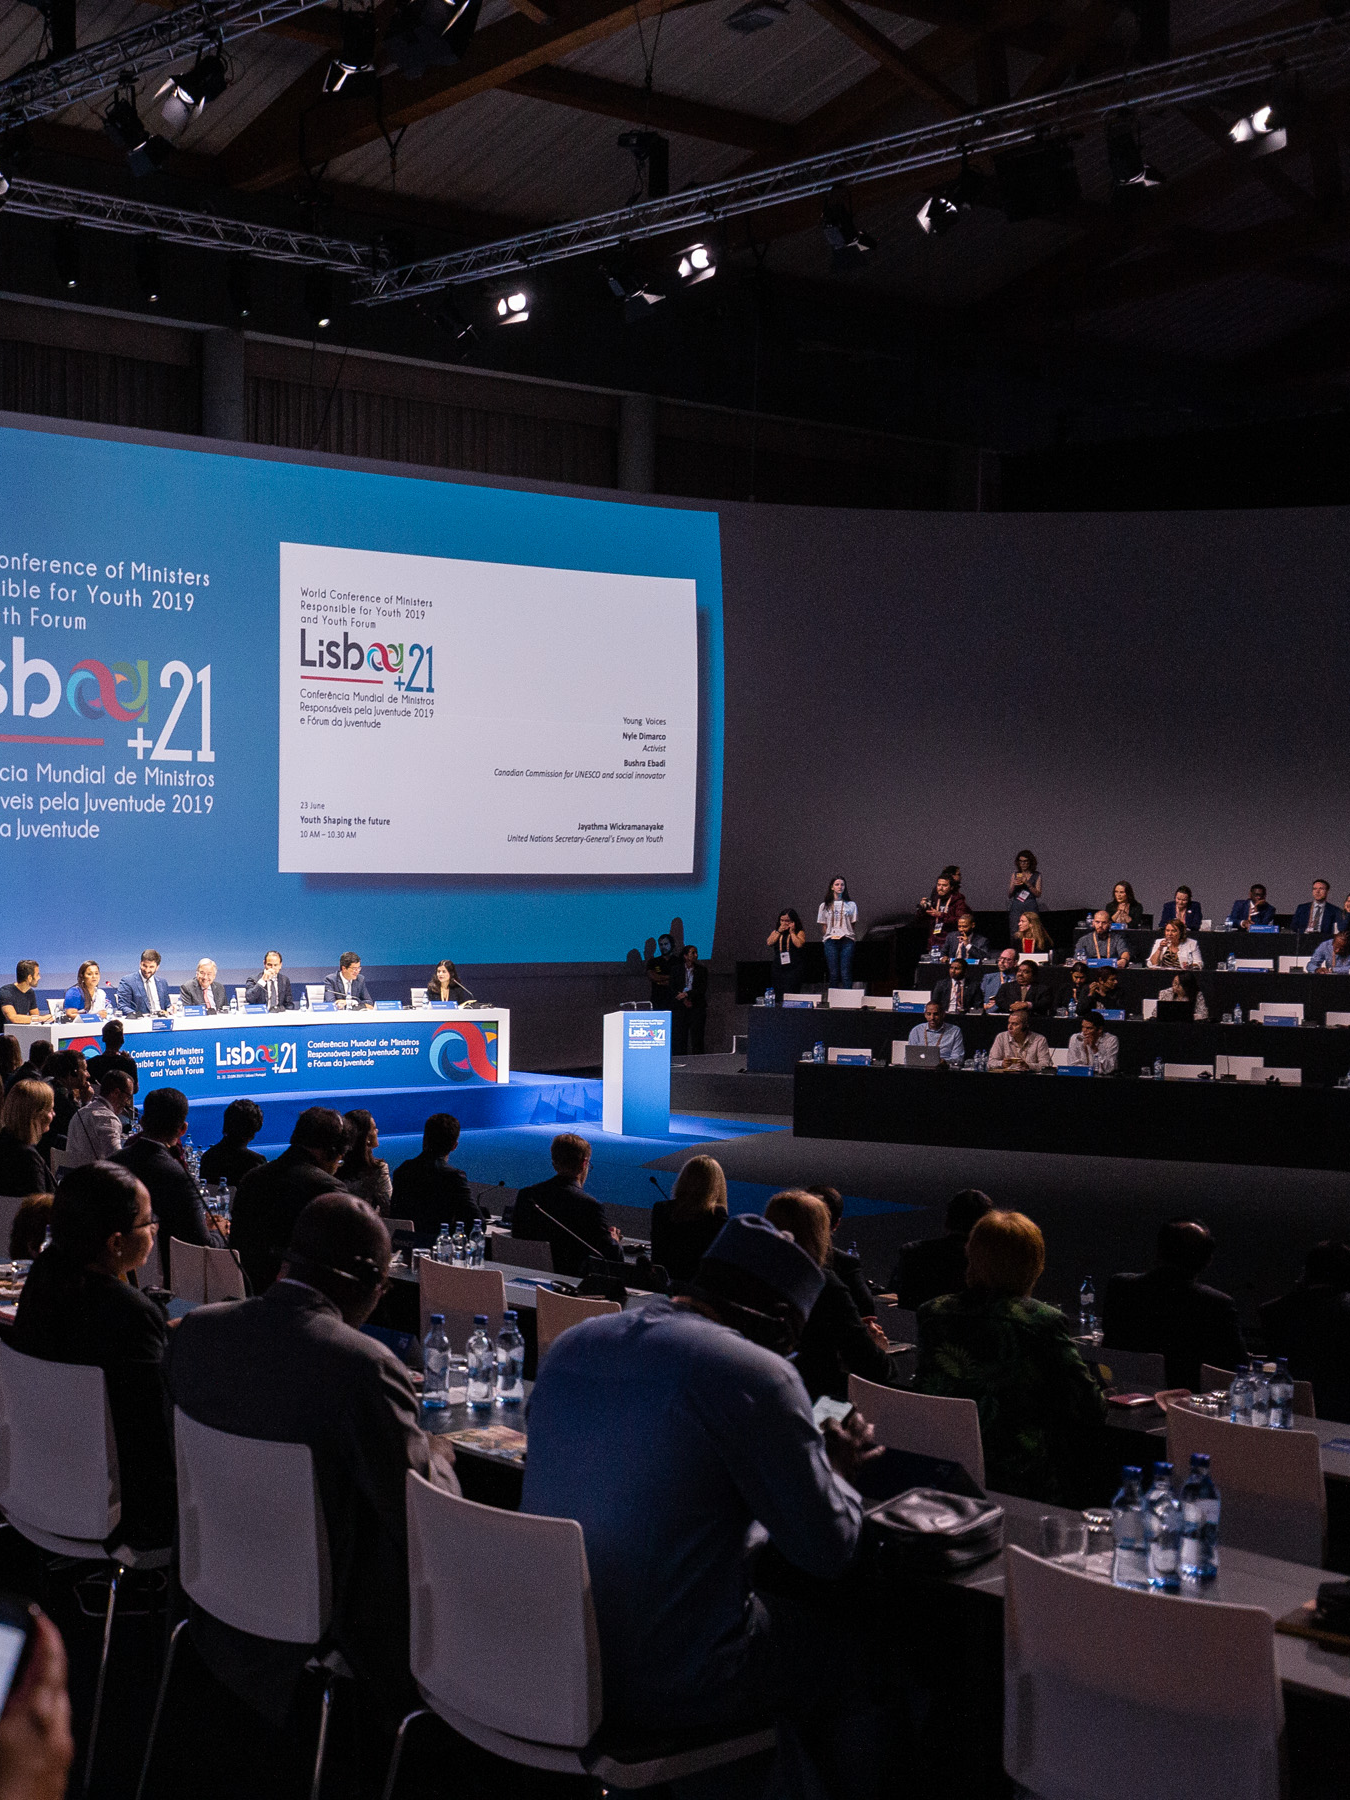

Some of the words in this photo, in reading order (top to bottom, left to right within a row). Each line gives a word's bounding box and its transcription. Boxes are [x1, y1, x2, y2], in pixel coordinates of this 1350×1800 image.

[106, 561, 122, 579] of
[131, 562, 210, 587] Ministers
[50, 582, 76, 602] for
[88, 585, 142, 608] Youth
[152, 591, 194, 611] 2019
[301, 587, 326, 598] World
[330, 590, 381, 604] Conference
[384, 596, 393, 604] of
[396, 596, 432, 607] Ministers
[301, 601, 356, 614] Responsible
[360, 606, 371, 615] for
[376, 607, 401, 618] Youth
[405, 609, 425, 619] 2019
[31, 608, 86, 630] Forum
[301, 615, 318, 624] and
[322, 616, 347, 626] Youth
[351, 618, 376, 628] Forum
[300, 688, 349, 700] Conferência
[353, 692, 384, 702] Mundial
[388, 694, 398, 703] de
[402, 695, 434, 705] Ministros
[300, 702, 352, 714] Responsáveis
[355, 706, 372, 716] pela
[374, 708, 411, 717] Juventude
[414, 708, 434, 718] 2019
[307, 715, 329, 726] Fórum
[332, 717, 342, 726] da
[344, 718, 381, 728] Juventude
[623, 717, 642, 726] Young
[622, 732, 637, 741] Nyle
[37, 763, 105, 784] Mundial
[114, 766, 136, 784] de
[145, 768, 214, 787] Ministros
[494, 768, 523, 777] Canadian
[525, 769, 562, 778] Commission
[563, 771, 573, 779] for
[602, 771, 614, 779] and
[616, 771, 633, 779] social
[635, 772, 665, 780] innovator
[40, 792, 79, 813] pela
[84, 792, 165, 814] Juventude
[172, 795, 213, 814] 2019
[300, 816, 321, 824] Youth
[323, 816, 351, 826] Shaping
[354, 817, 366, 825] the
[369, 817, 390, 825] future
[578, 823, 608, 831] Jayathma
[609, 823, 664, 831] Wickramanayake
[17, 818, 100, 840] Juventude
[616, 835, 634, 844] Envoy
[307, 1040, 348, 1048] Conferência
[379, 1039, 388, 1047] de
[131, 1049, 166, 1058] Conference
[169, 1048, 175, 1056] of
[176, 1047, 204, 1056] Ministers
[308, 1050, 350, 1059] Responsáveis
[352, 1049, 366, 1058] pela
[368, 1048, 399, 1057] Juventude
[156, 1059, 165, 1067] for
[167, 1058, 186, 1067] Youth
[189, 1056, 204, 1065] 2019
[344, 1059, 374, 1067] Juventude
[150, 1068, 163, 1077] and
[165, 1068, 183, 1076] Youth
[185, 1067, 204, 1075] Forum
